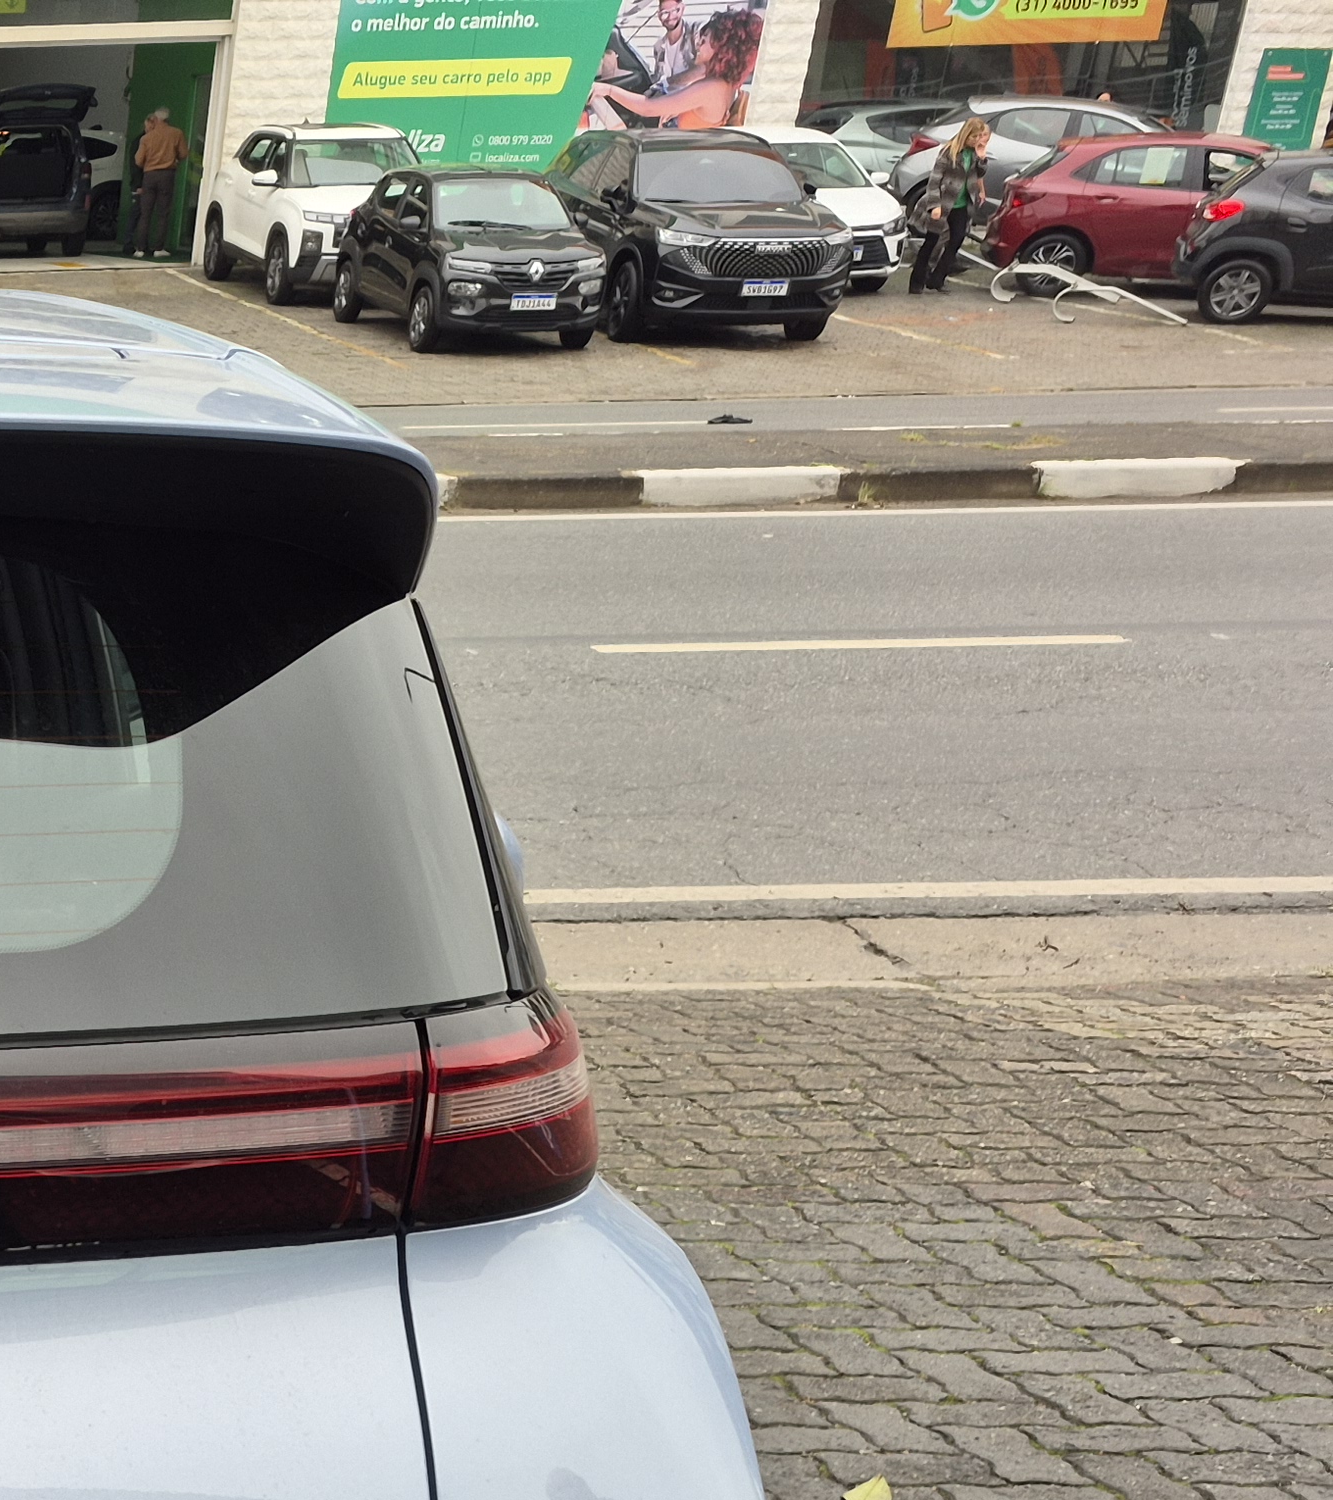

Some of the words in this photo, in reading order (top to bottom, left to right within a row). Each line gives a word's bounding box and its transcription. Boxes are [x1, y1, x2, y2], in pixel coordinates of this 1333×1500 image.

[351, 17, 362, 32] o
[367, 13, 430, 31] melhor
[433, 12, 455, 30] do
[460, 10, 539, 30] caminho.
[352, 72, 406, 89] Alugue
[411, 74, 438, 85] seu
[442, 73, 481, 84] carro
[486, 68, 519, 86] pelo
[524, 71, 552, 86] app
[1175, 46, 1198, 127] seminovos
[408, 129, 446, 152] liza
[488, 135, 510, 145] 0800
[511, 135, 528, 145] 979
[530, 134, 553, 145] 2020
[485, 152, 540, 163] localiza.com
